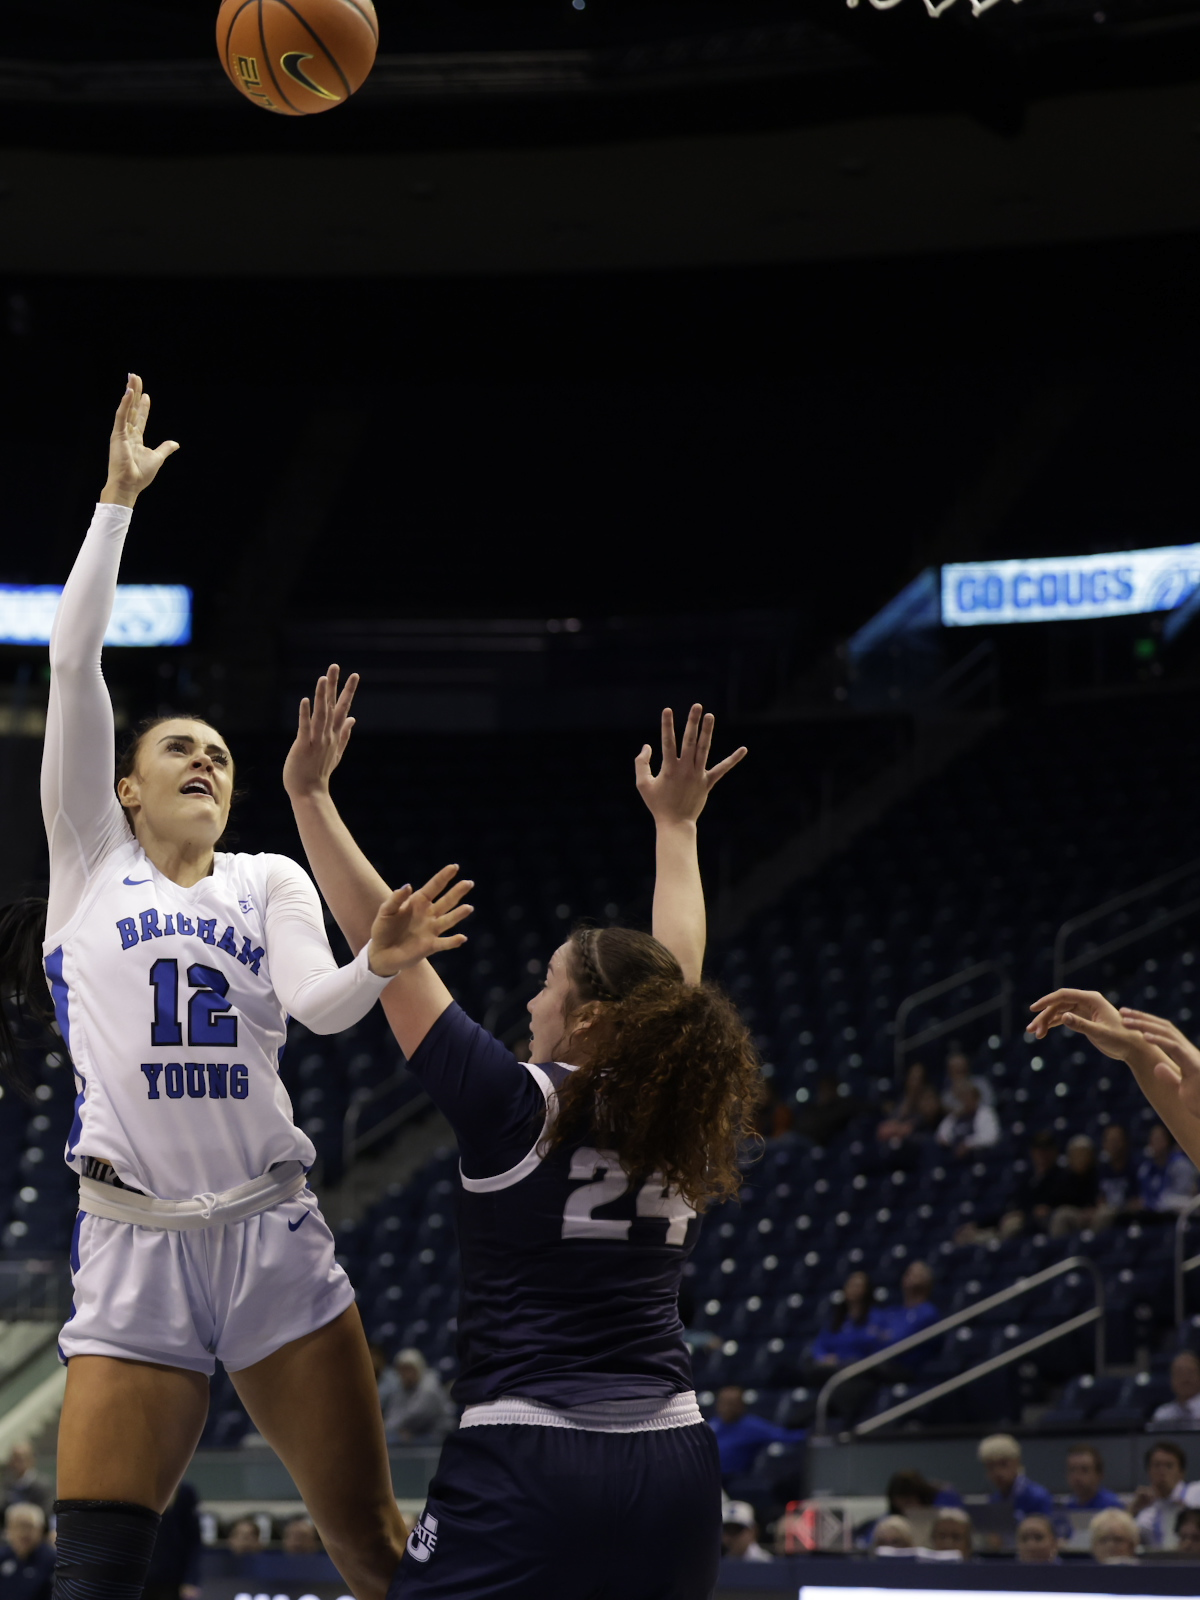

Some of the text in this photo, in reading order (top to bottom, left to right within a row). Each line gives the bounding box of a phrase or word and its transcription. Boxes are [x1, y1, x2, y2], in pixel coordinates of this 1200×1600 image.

[957, 566, 1135, 612] GO COUGS
[116, 908, 265, 976] BRIGHAM
[149, 958, 238, 1047] 12
[140, 1062, 249, 1100] YOUNG
[561, 1146, 697, 1246] 24
